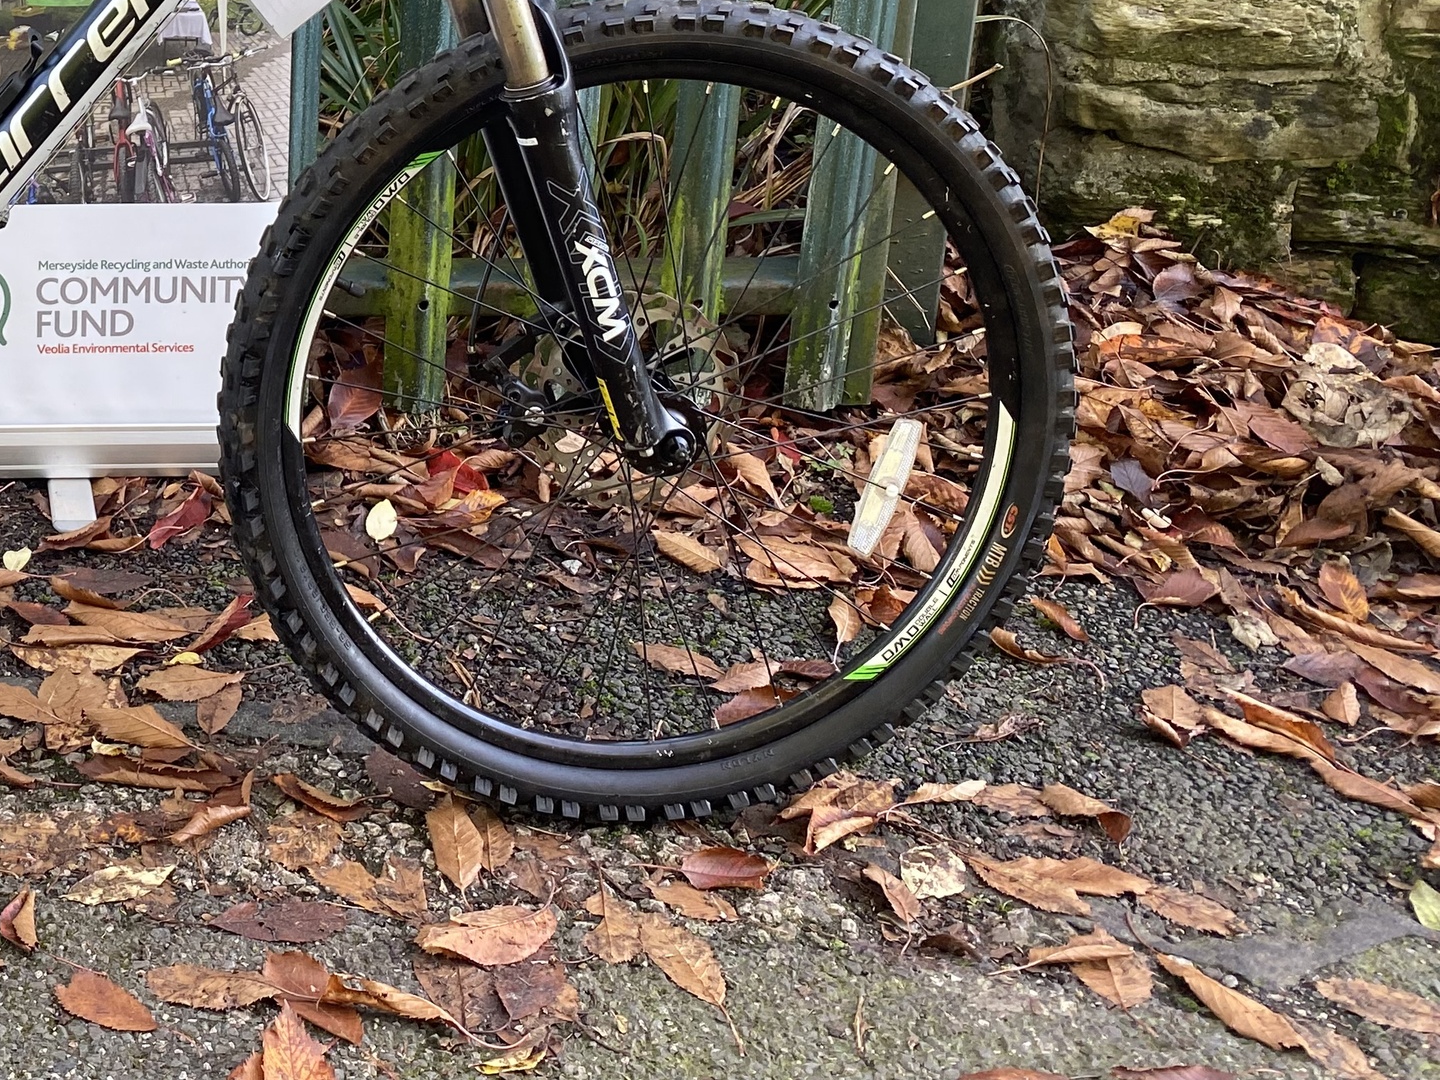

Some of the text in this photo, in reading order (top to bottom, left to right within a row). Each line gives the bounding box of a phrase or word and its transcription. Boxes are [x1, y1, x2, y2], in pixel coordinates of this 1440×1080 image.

[38, 259, 98, 273] Merseyside
[101, 259, 151, 272] Recycling
[153, 259, 172, 270] and
[174, 259, 209, 270] Waste
[573, 240, 630, 342] XCM
[36, 310, 134, 338] FUND
[37, 342, 195, 354] Veolia Environmental Services
[985, 541, 1008, 570] MTB
[959, 587, 985, 622] TRACTION
